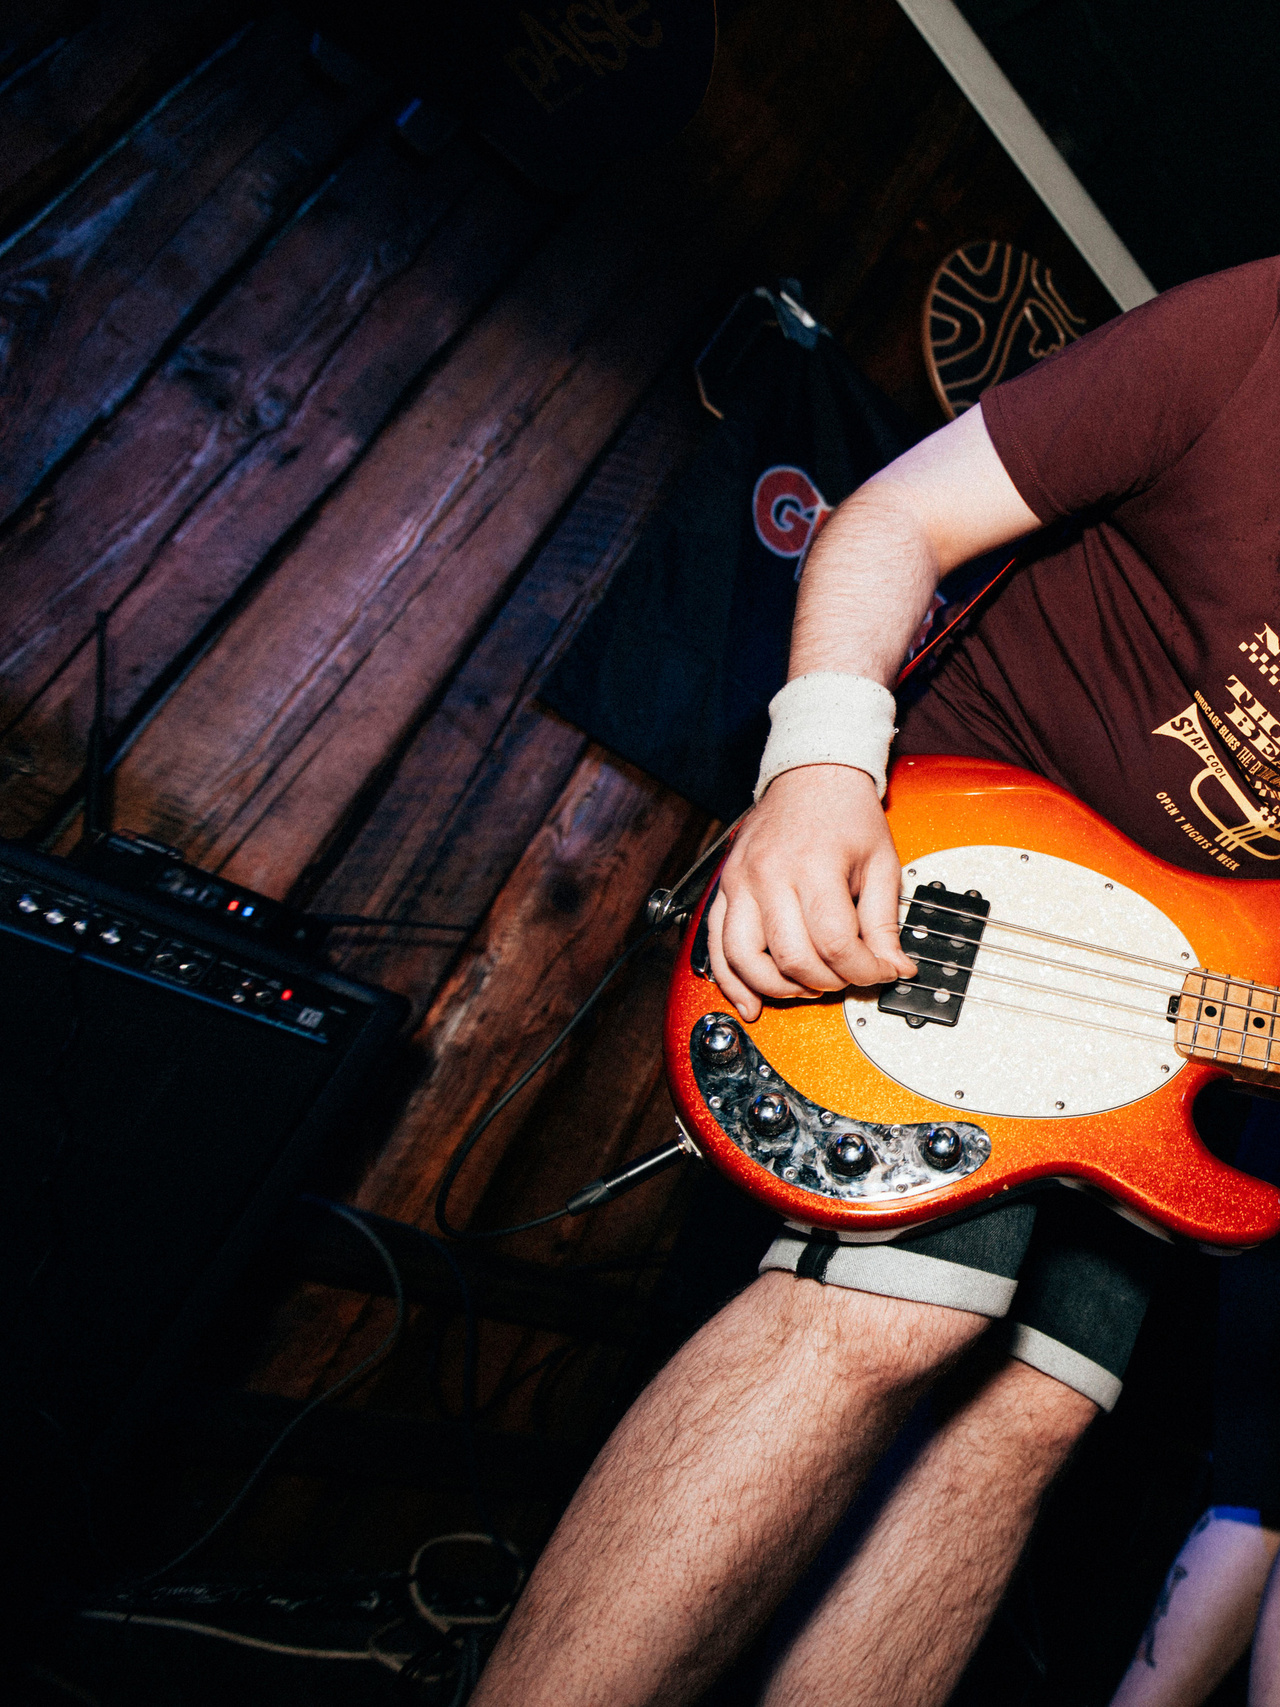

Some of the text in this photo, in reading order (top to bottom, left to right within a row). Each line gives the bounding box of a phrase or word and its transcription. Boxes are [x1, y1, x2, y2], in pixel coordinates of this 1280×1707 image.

[1170, 717, 1226, 779] STAY COOL
[1193, 689, 1256, 768] BIRDCAGE BLUES THE
[1156, 792, 1180, 816] OPEN
[1180, 823, 1213, 849] NIGHTS
[1216, 853, 1240, 871] WEEK
